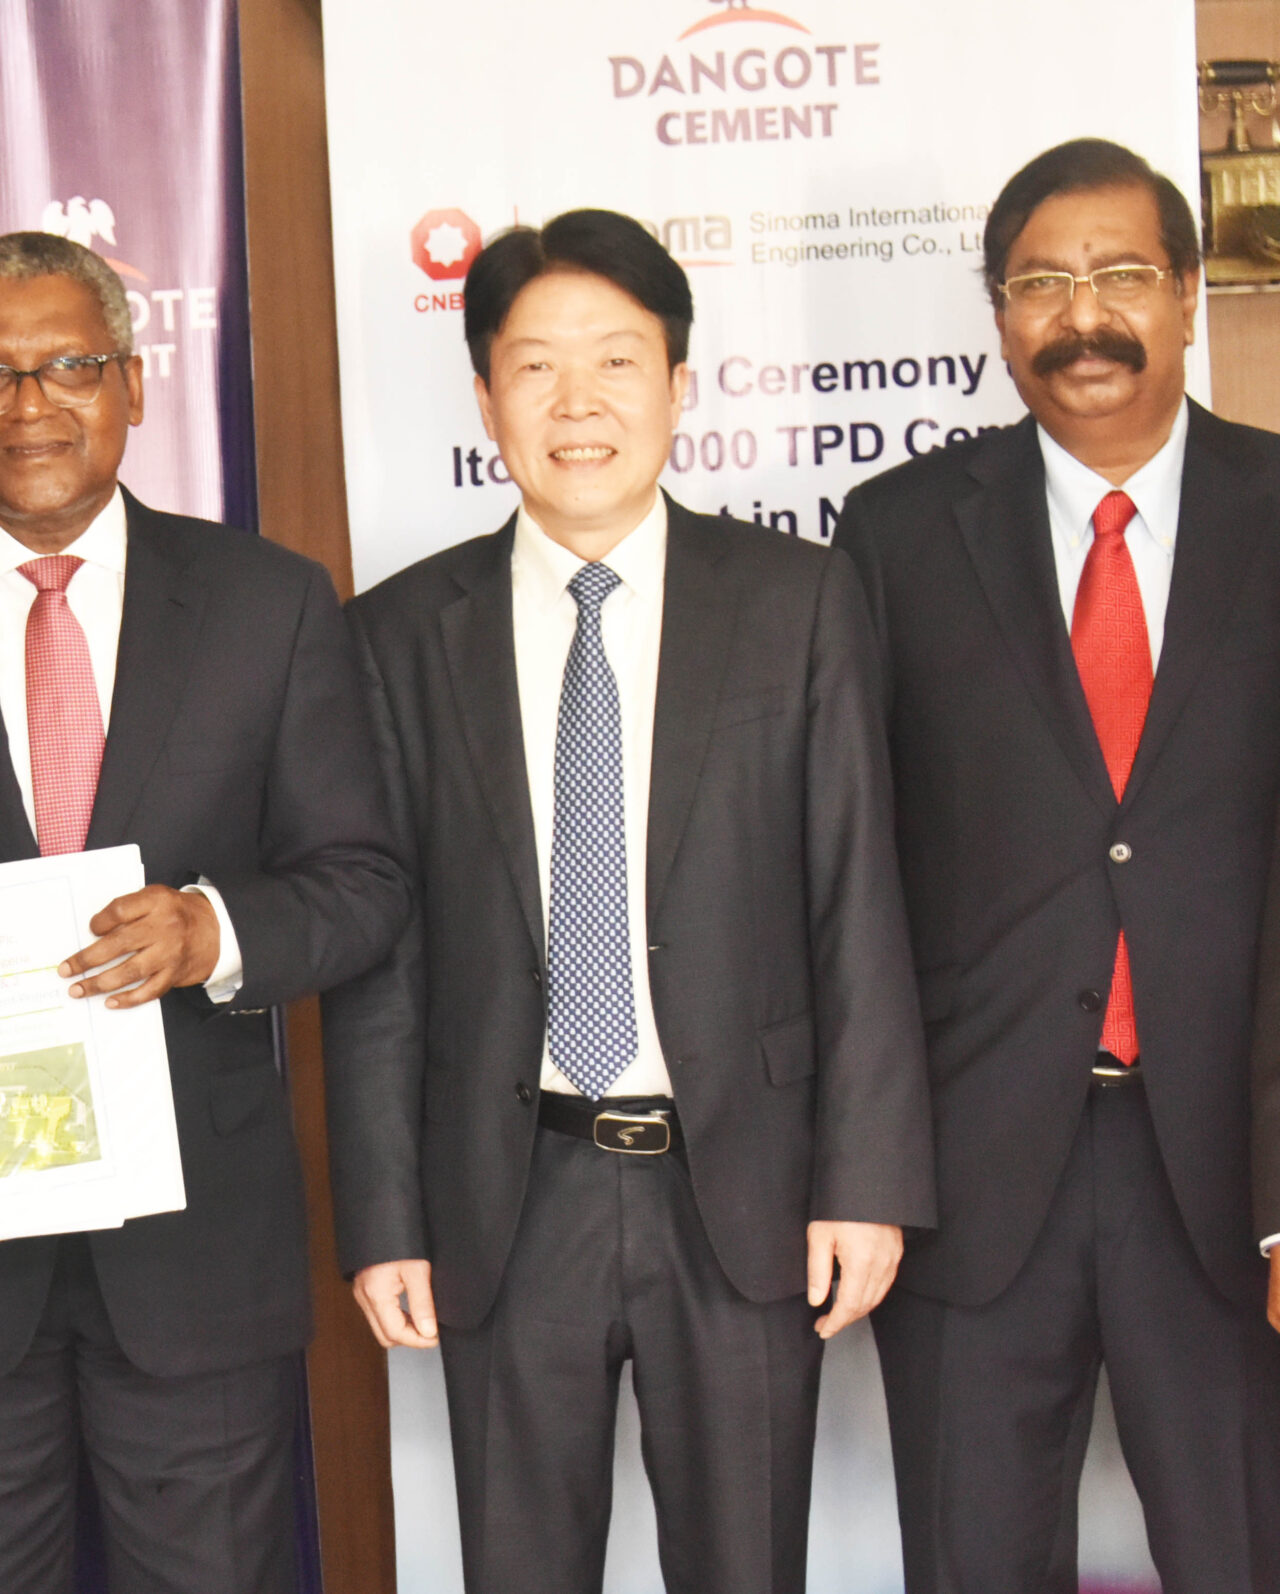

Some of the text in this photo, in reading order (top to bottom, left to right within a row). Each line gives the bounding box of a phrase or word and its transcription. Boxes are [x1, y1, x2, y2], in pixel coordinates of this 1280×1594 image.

[608, 43, 880, 99] DANGOTE
[656, 103, 838, 146] CEMENT
[750, 201, 992, 233] Sinoma Internationa
[751, 236, 893, 267] Engineering
[902, 233, 951, 256] Co.,
[718, 354, 987, 397] Ceremony
[775, 421, 885, 466] TPD
